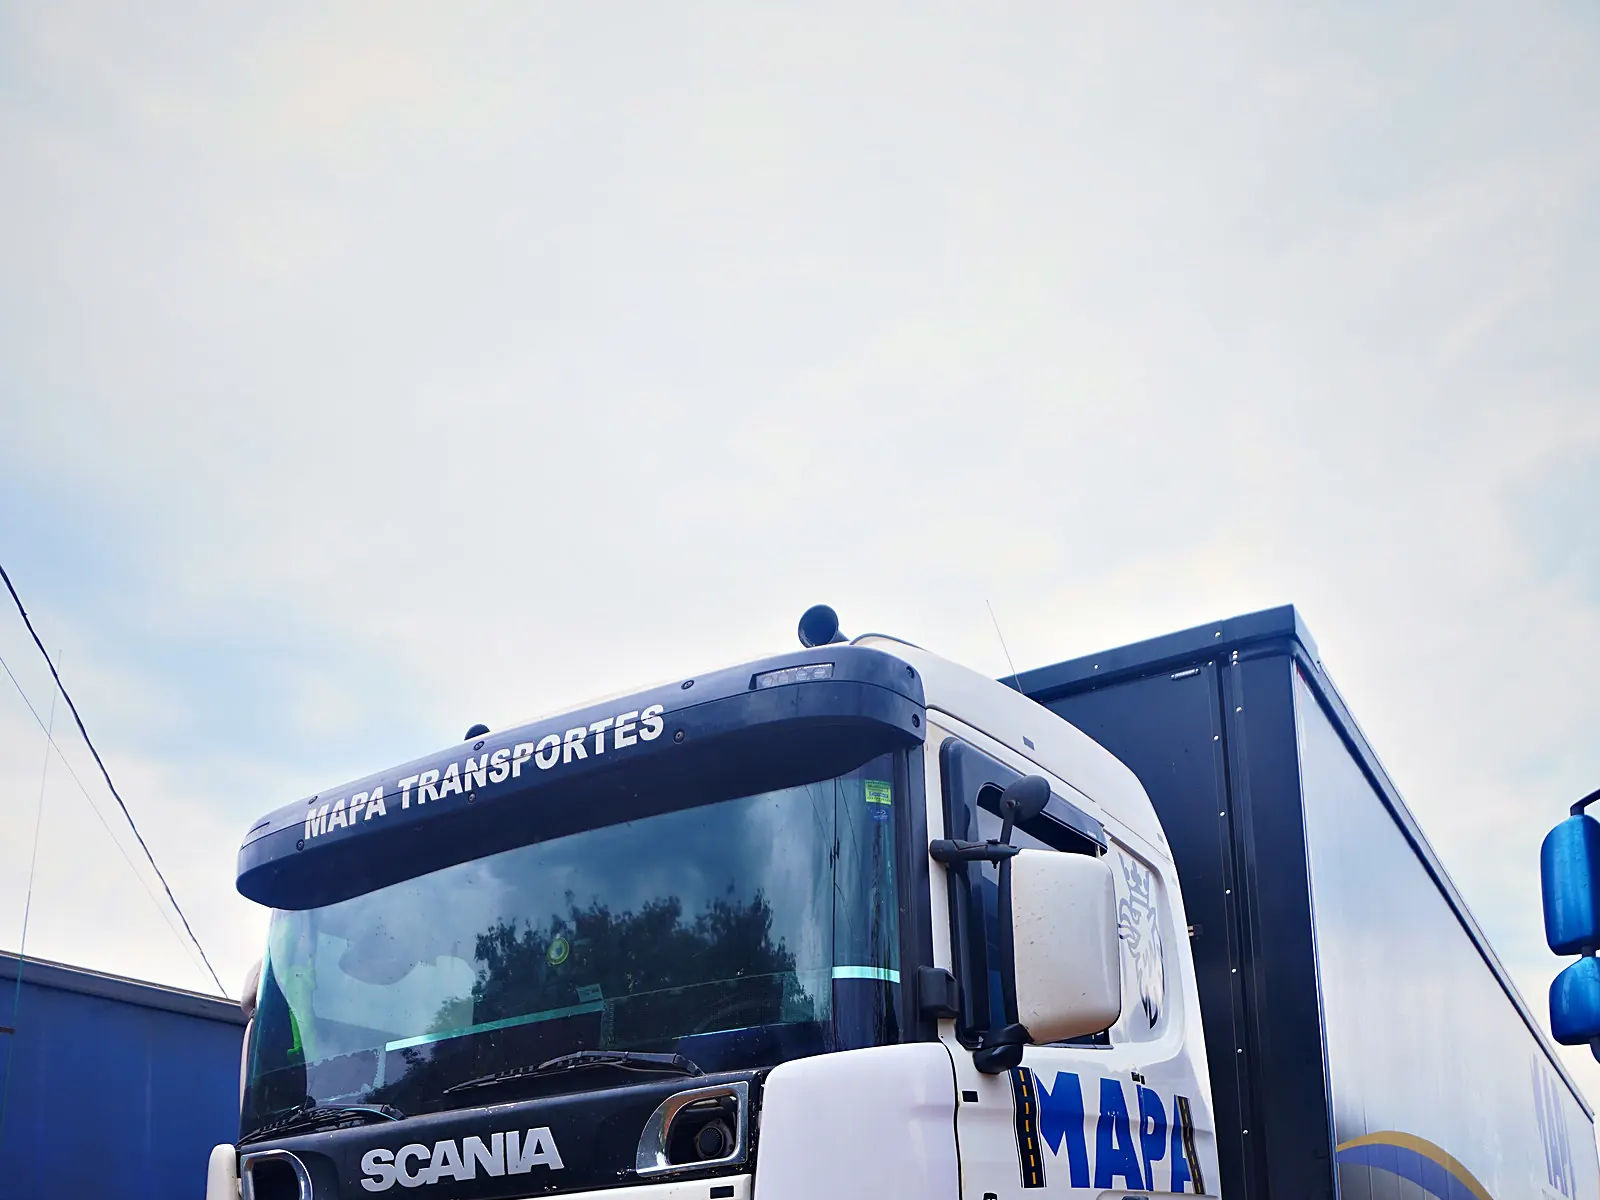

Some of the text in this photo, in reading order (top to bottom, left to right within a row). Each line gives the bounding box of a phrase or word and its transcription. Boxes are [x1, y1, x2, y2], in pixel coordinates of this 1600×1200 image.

[304, 704, 664, 840] MAPA TRANSPORTES
[360, 1126, 565, 1193] SCANIA
[1008, 1066, 1206, 1195] MAPA
